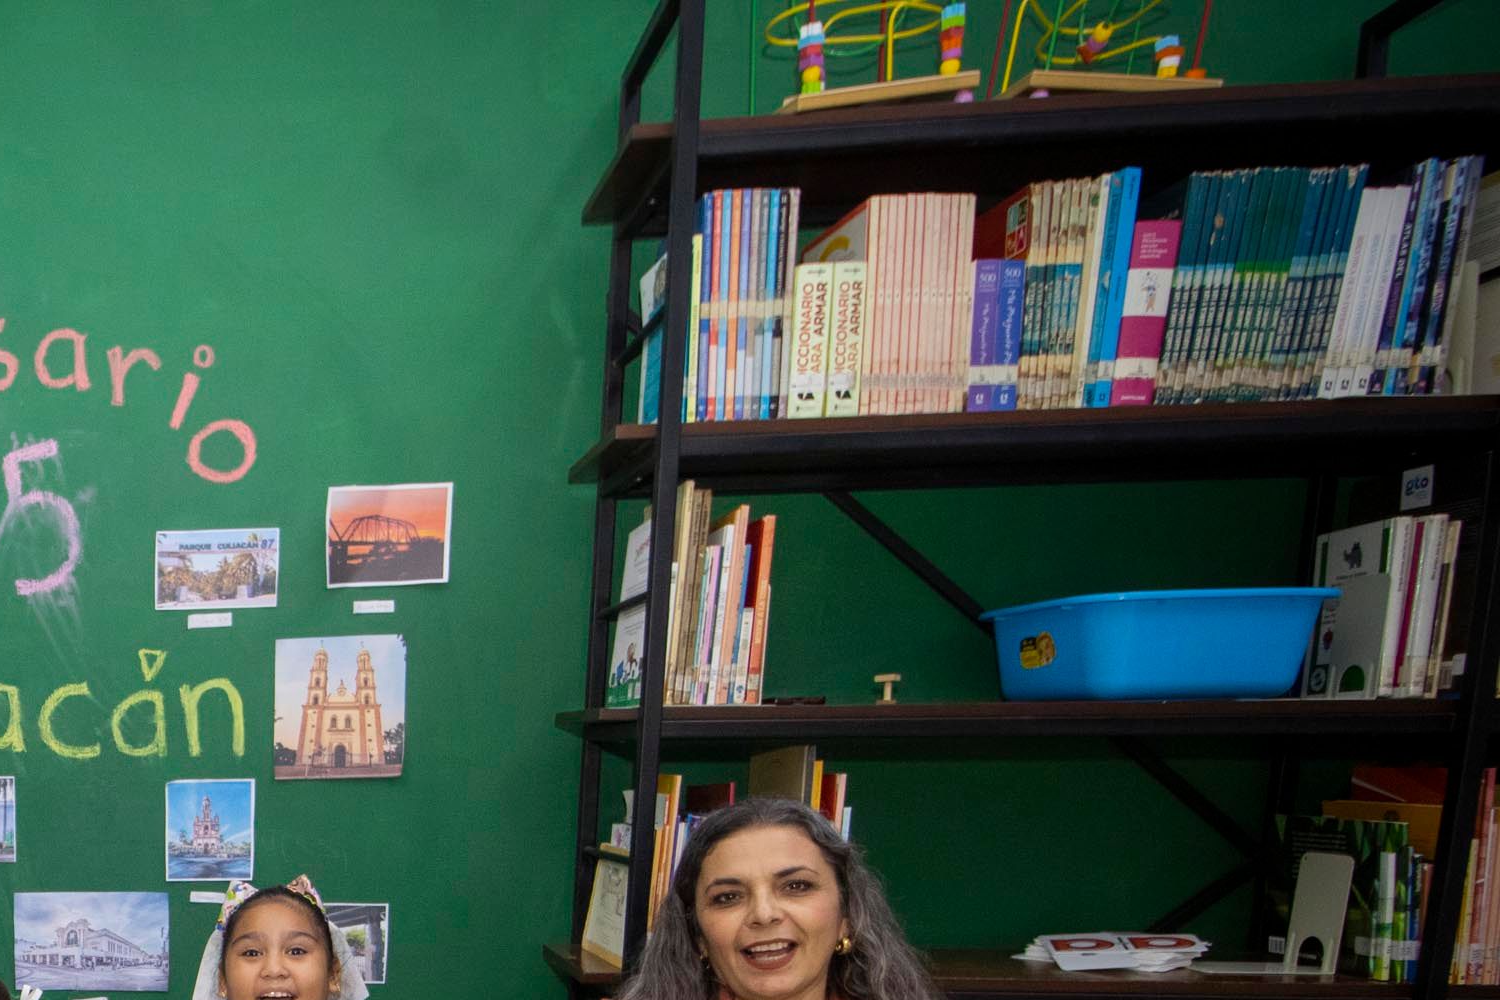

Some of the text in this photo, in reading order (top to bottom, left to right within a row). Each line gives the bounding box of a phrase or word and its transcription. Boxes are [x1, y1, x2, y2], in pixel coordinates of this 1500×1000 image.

[797, 283, 814, 374] ICCIONARIO
[814, 282, 827, 336] ARMAR
[835, 281, 850, 373] ICCIONARIO
[848, 281, 862, 370] ARA ARMAR
[811, 343, 822, 374] ARA
[260, 538, 275, 549] 87
